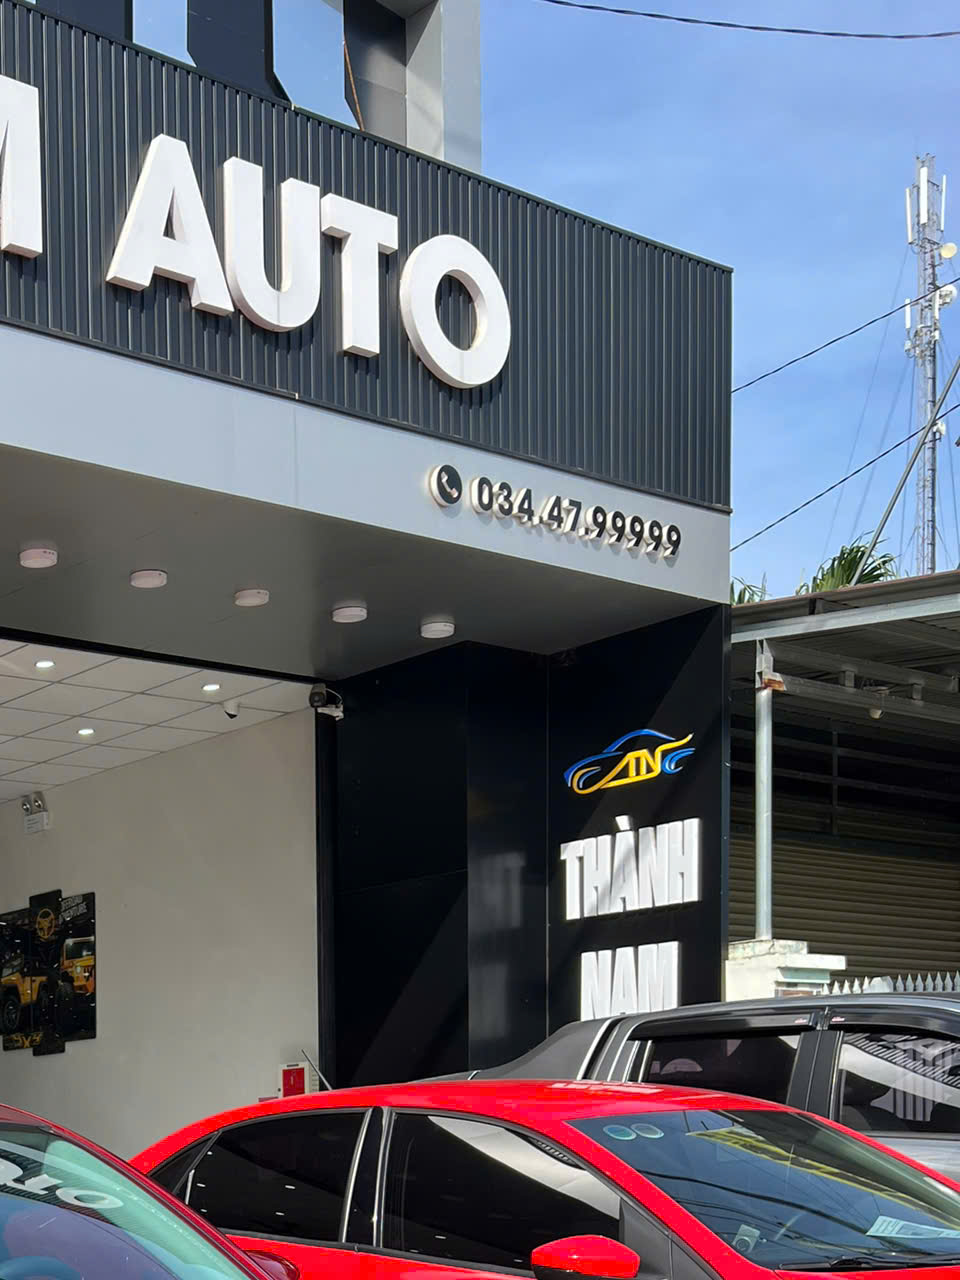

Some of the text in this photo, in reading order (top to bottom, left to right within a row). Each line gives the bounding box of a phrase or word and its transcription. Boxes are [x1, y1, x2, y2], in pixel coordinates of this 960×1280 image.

[106, 133, 512, 389] AUTO
[470, 476, 682, 557] 034.47.99999
[560, 814, 703, 921] THÀNH
[580, 940, 680, 1020] NAM
